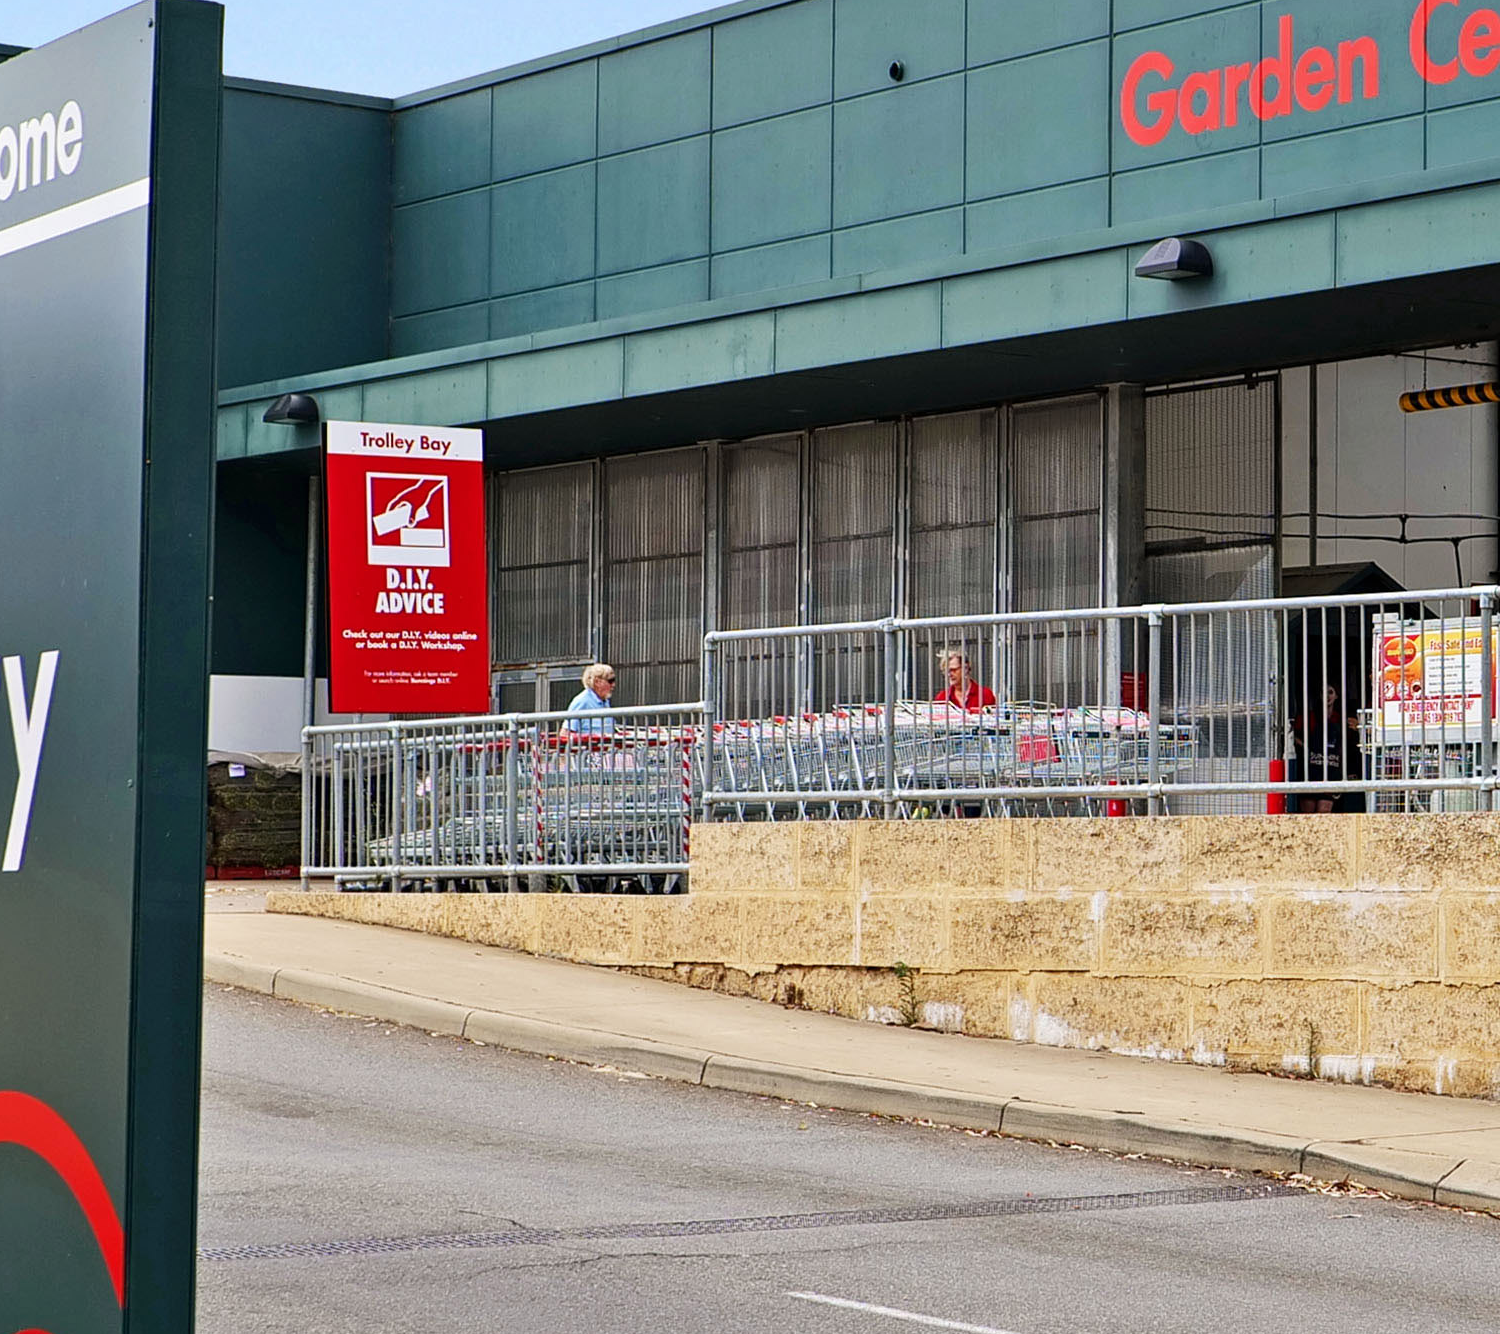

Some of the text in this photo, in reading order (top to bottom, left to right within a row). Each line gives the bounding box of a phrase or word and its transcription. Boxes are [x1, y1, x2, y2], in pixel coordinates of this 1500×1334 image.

[1119, 13, 1380, 147] Garden
[360, 431, 452, 456] Trolley Bay
[386, 567, 434, 590] D.I.Y.
[375, 591, 445, 614] ADVICE
[342, 629, 477, 641] Check out our D.I.Y. videos online
[355, 641, 365, 649] or
[367, 640, 389, 650] book
[399, 640, 419, 650] D.I.Y.
[421, 641, 466, 652] Workshop.
